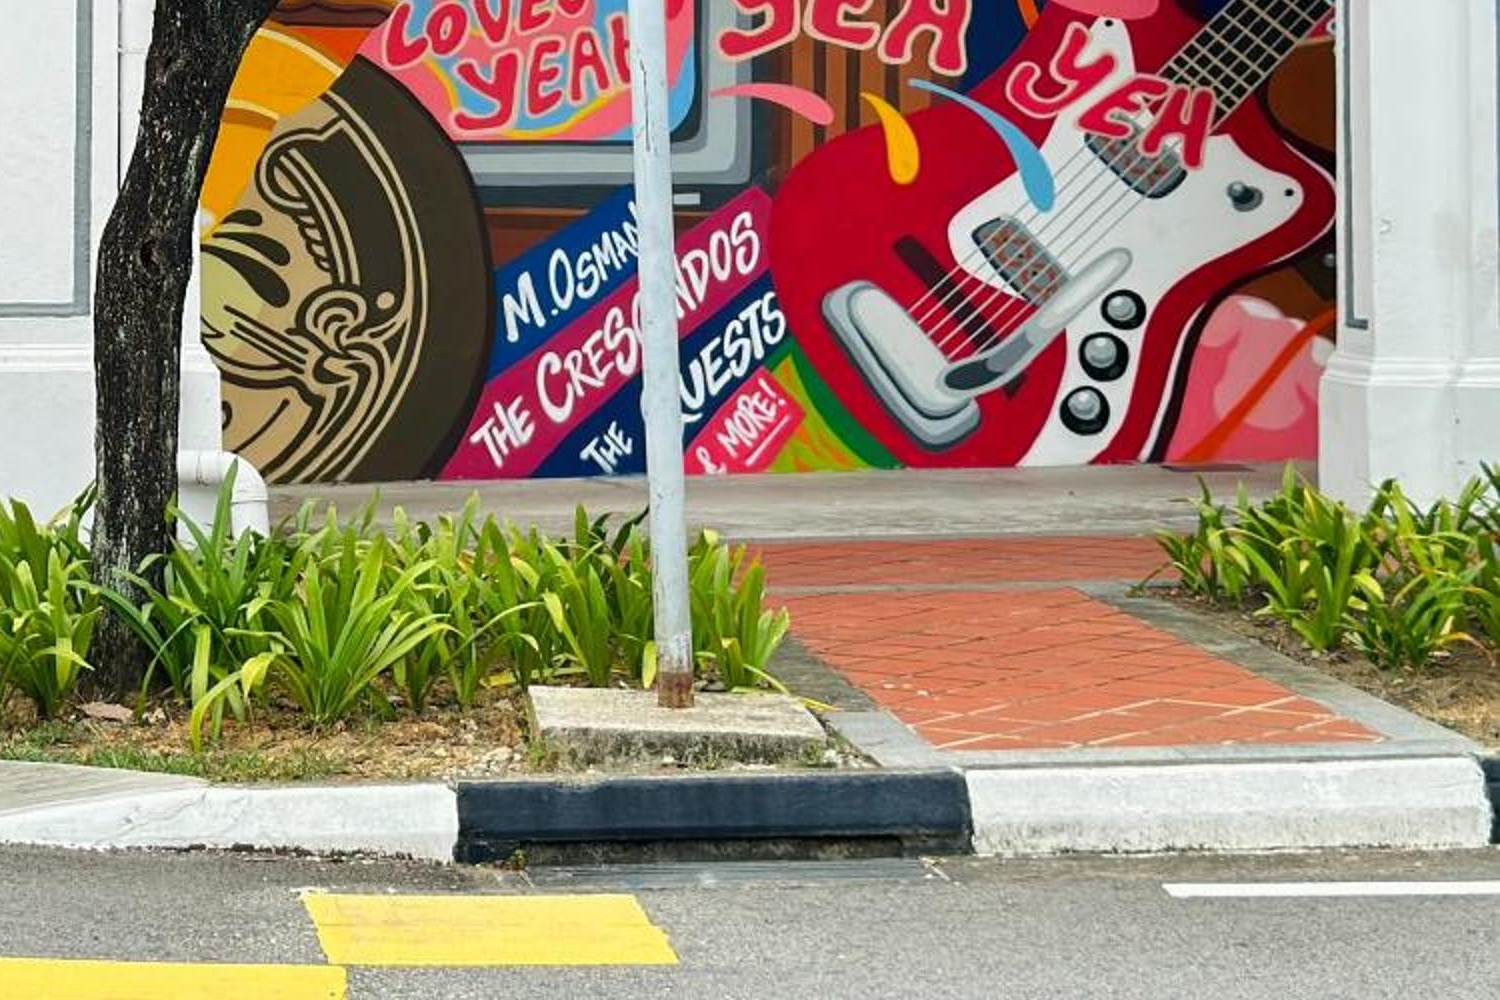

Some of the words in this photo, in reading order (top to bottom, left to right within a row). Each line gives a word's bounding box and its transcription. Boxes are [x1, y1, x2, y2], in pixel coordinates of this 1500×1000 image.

[1005, 21, 1216, 169] YEH
[470, 396, 535, 469] THE
[579, 421, 633, 474] THE
[678, 291, 787, 424] UESTS
